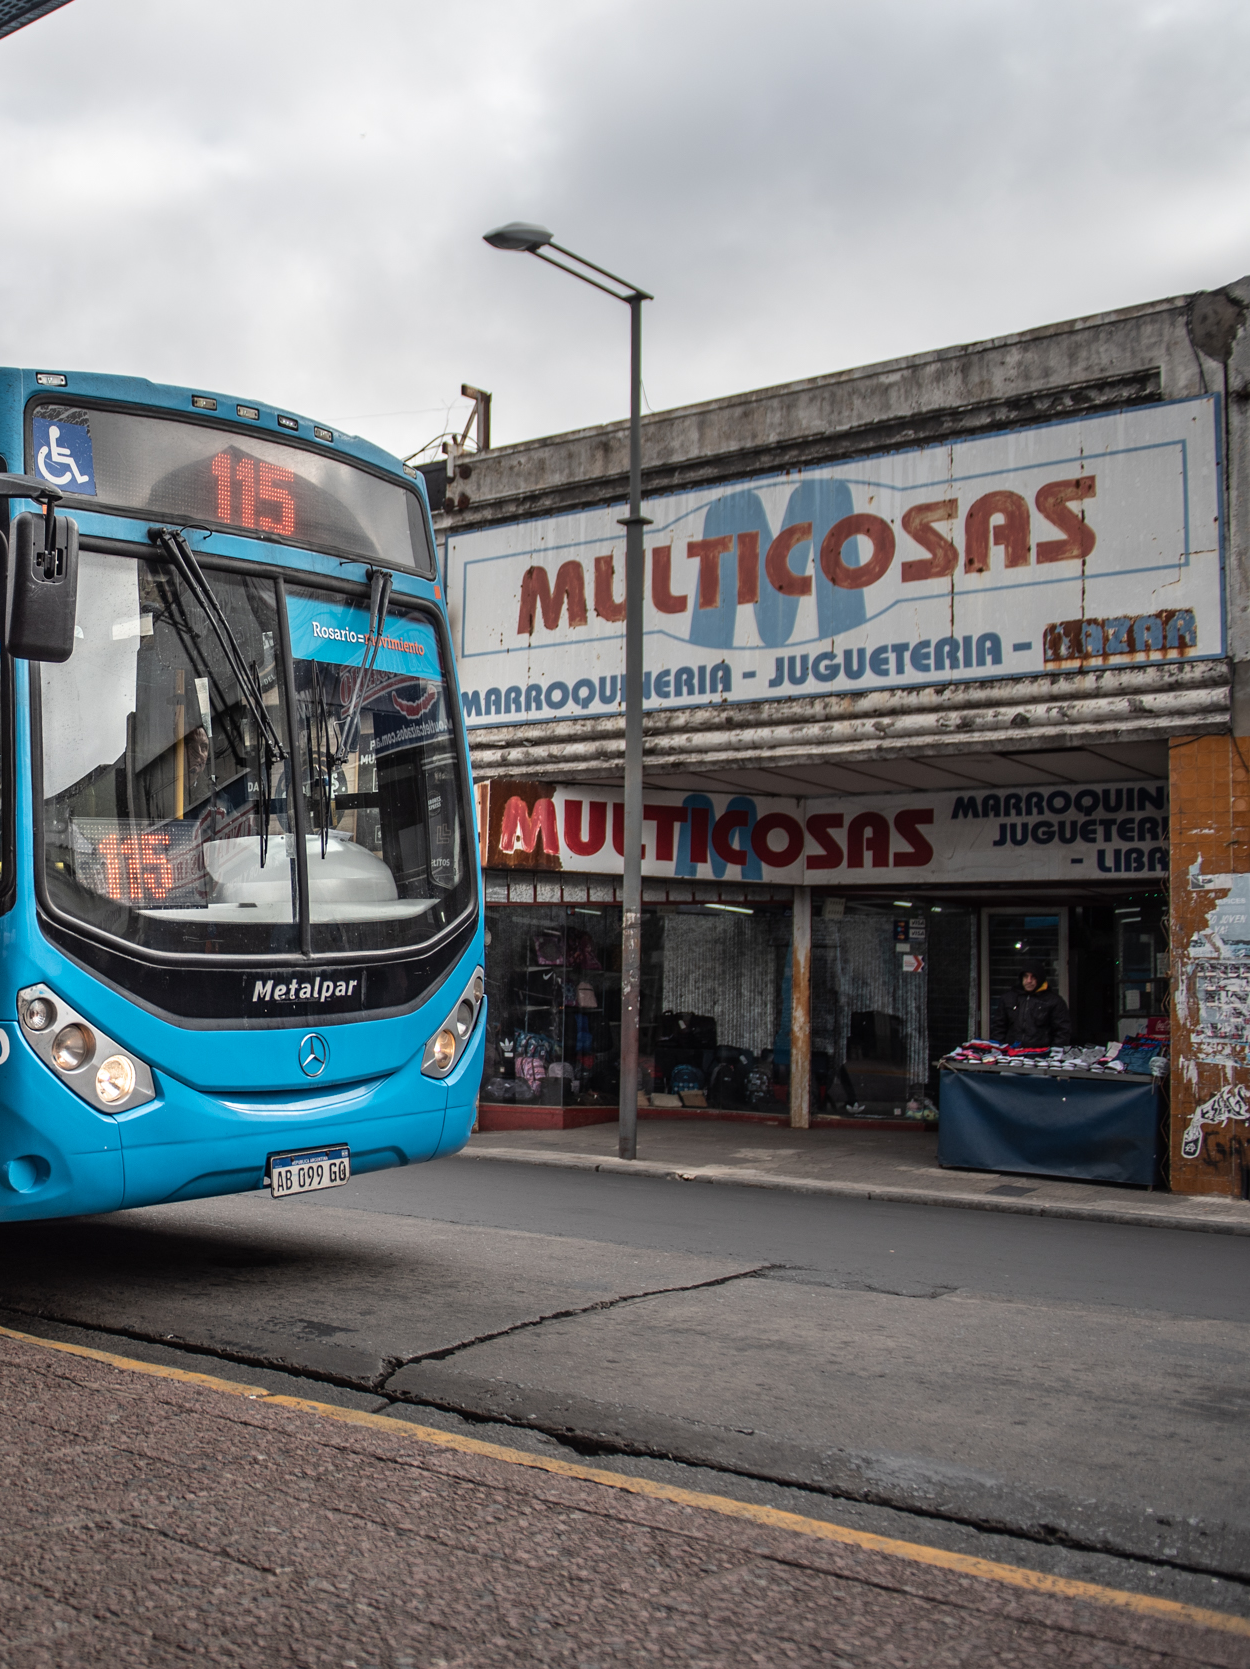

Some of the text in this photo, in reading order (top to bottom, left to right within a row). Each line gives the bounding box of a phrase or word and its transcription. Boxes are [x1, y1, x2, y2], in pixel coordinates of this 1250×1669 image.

[211, 452, 295, 536] 115
[516, 475, 1098, 635] MULTICOSAS
[767, 631, 1003, 690] JUGUETERIA
[360, 753, 377, 765] MU
[950, 786, 1170, 820] MARROQUIN
[98, 834, 172, 899] 115
[1219, 914, 1248, 924] JOVEN
[252, 976, 358, 1003] Metalpar
[277, 1169, 294, 1193] AB
[298, 1164, 324, 1188] 099
